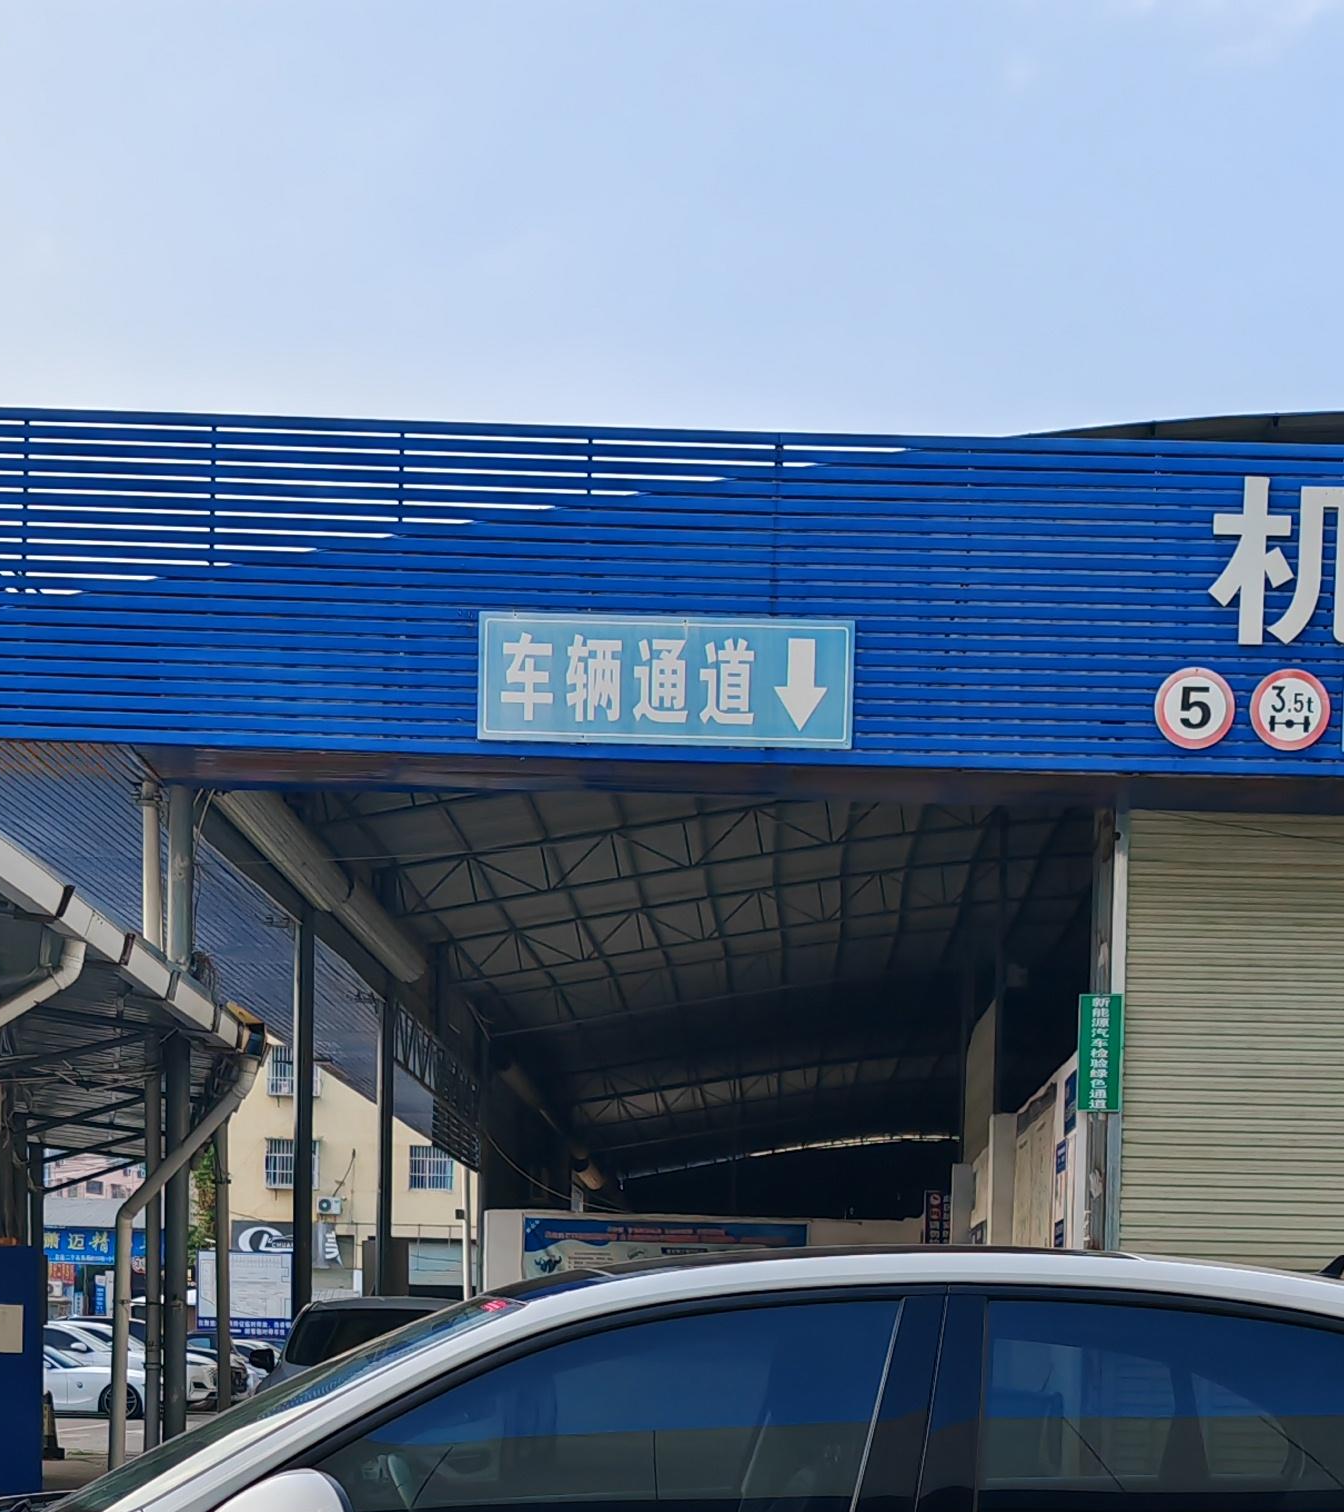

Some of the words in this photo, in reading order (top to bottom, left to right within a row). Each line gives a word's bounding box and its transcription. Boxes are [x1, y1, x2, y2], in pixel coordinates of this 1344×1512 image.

[500, 632, 755, 725] 车辆通道
[1179, 686, 1211, 729] 5
[1271, 685, 1314, 714] 3.5t
[1088, 997, 1110, 1109] 新能源汽车检验绿色通道
